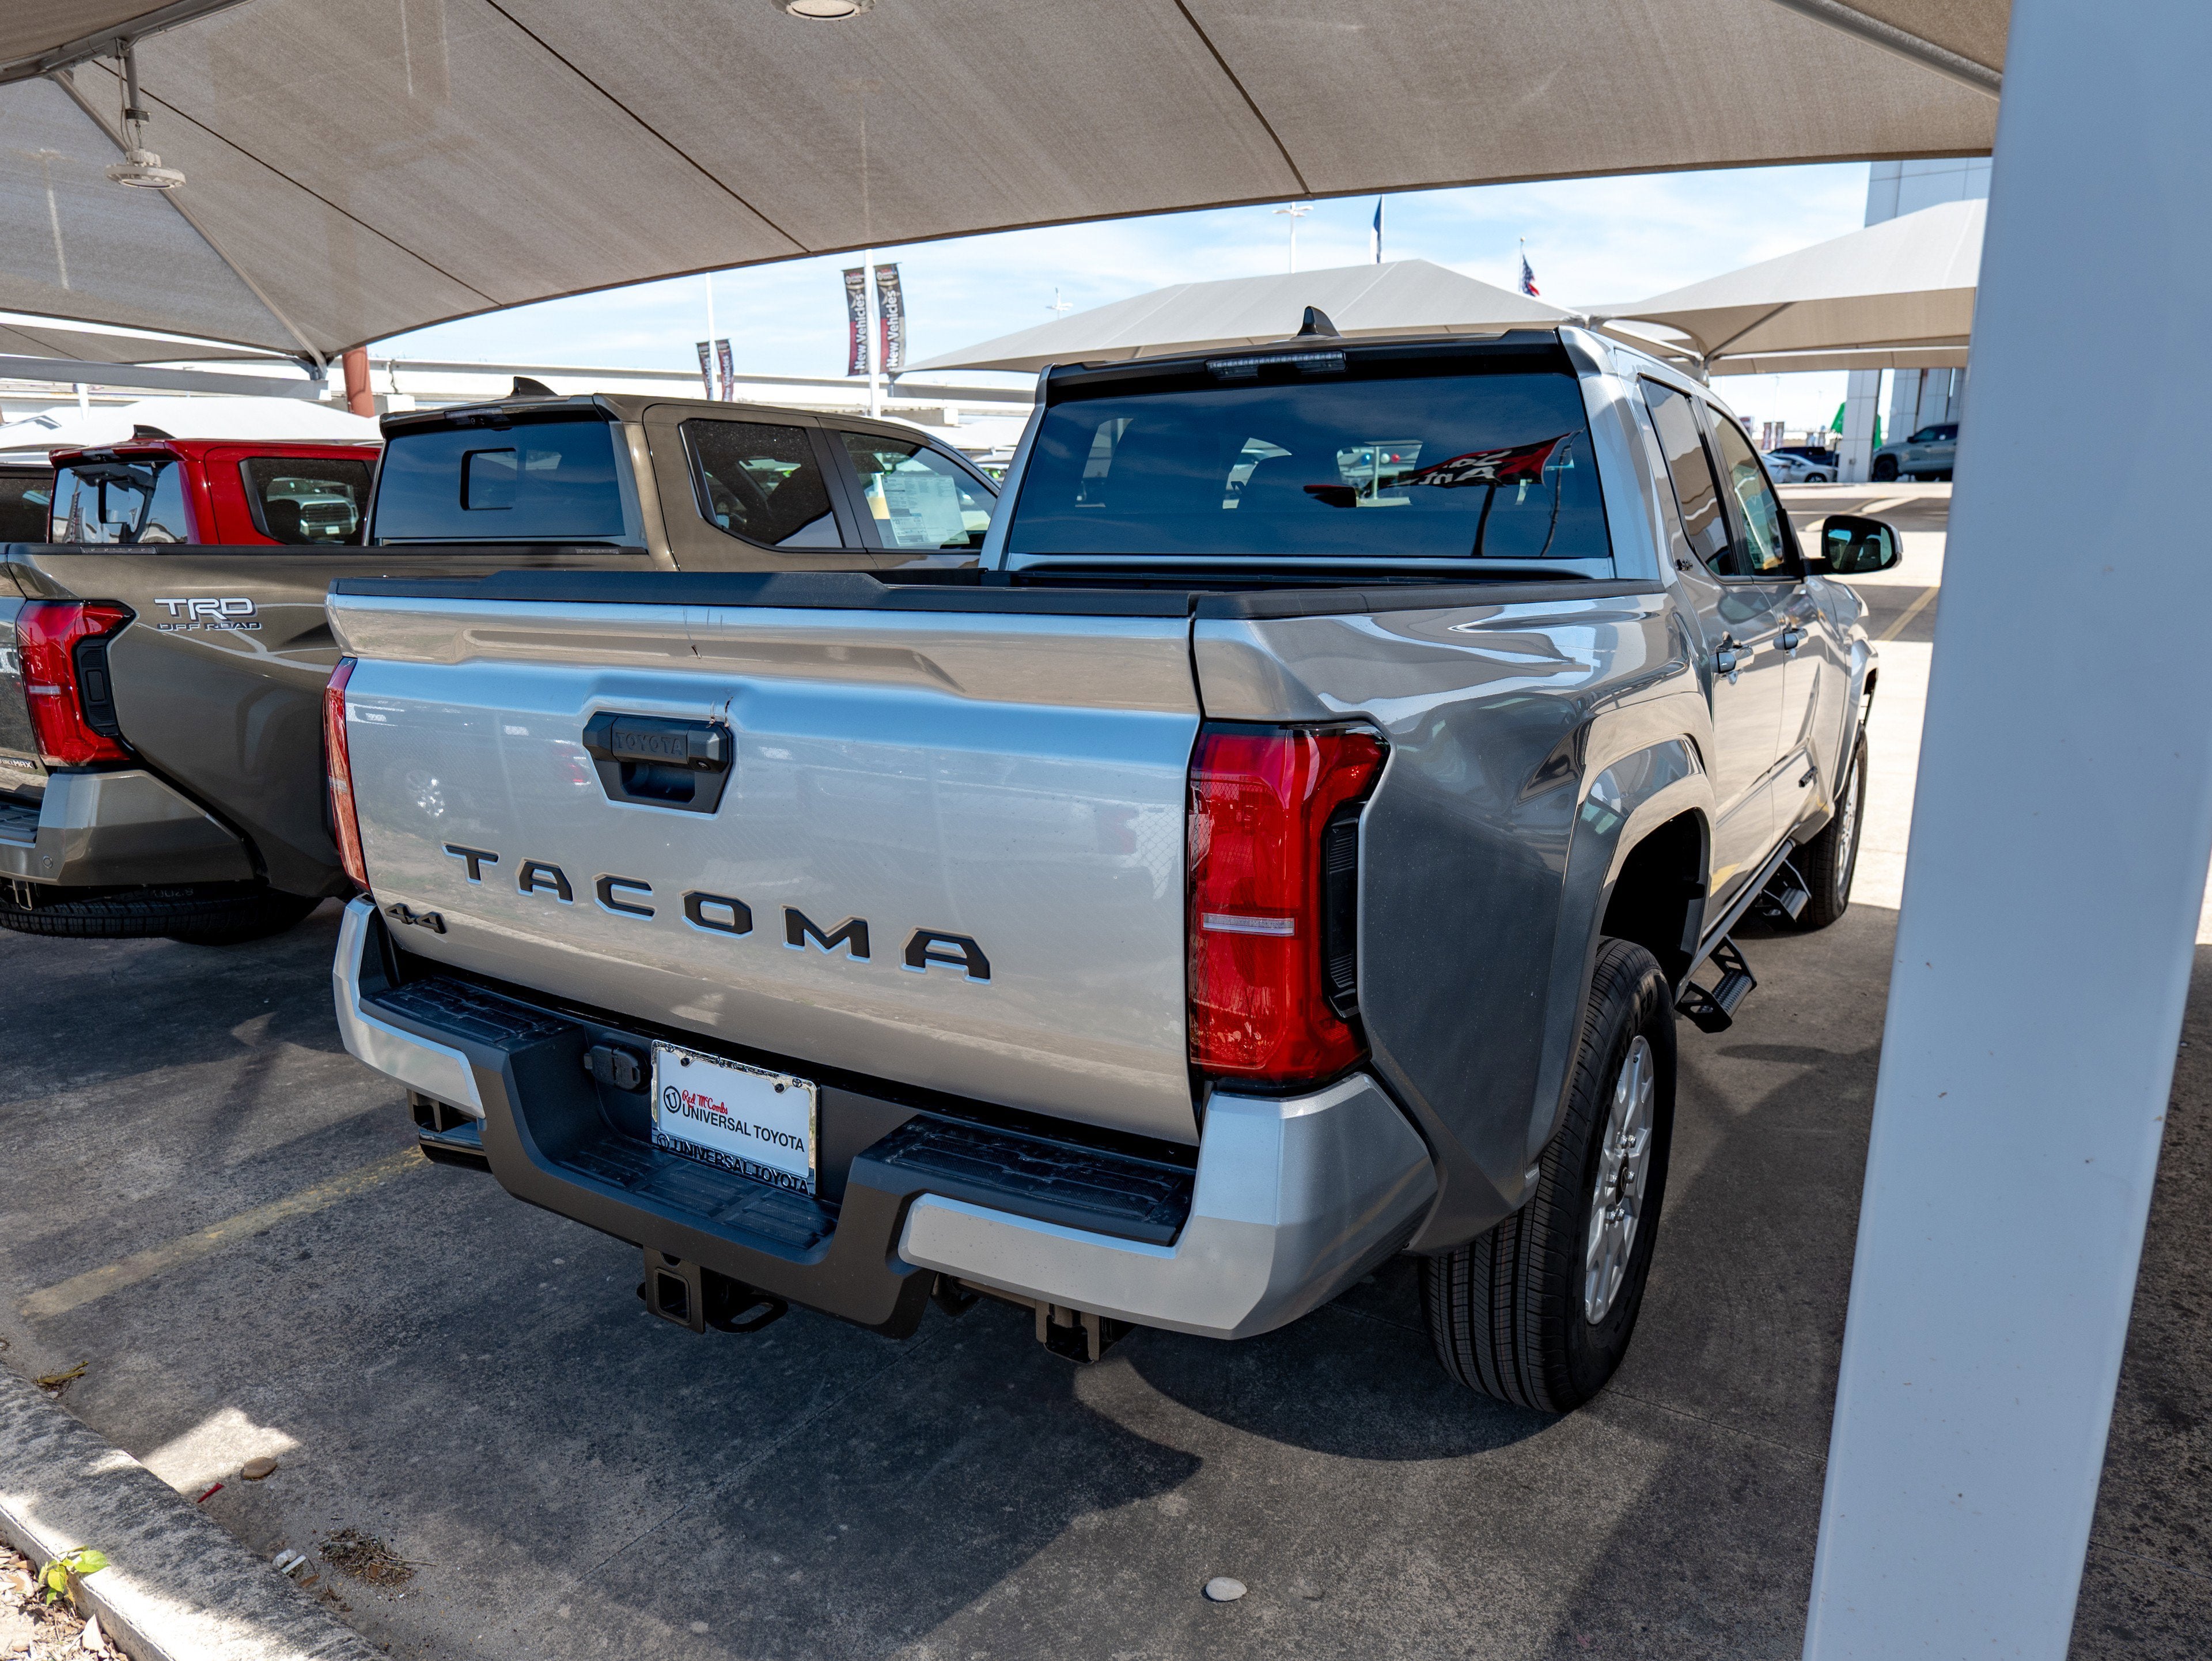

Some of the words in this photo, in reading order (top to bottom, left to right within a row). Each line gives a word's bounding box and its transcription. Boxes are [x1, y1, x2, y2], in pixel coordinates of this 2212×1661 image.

[854, 293, 867, 343] Vehicles
[885, 290, 899, 340] Vehicles
[854, 344, 867, 370] New
[885, 341, 899, 368] New
[154, 597, 257, 622] TRD
[157, 623, 200, 631] OFF
[203, 622, 263, 631] ROAD
[615, 731, 684, 756] TOYOTA
[12, 760, 33, 769] MAX
[441, 841, 991, 985] TACOMA
[682, 1089, 696, 1108] Red
[696, 1094, 729, 1115] McCombs
[683, 1103, 752, 1137] UNIVERSAL
[753, 1124, 805, 1153] TOYOTA
[673, 1138, 752, 1176] UNIVERSAL
[752, 1164, 810, 1195] TOYOTA
